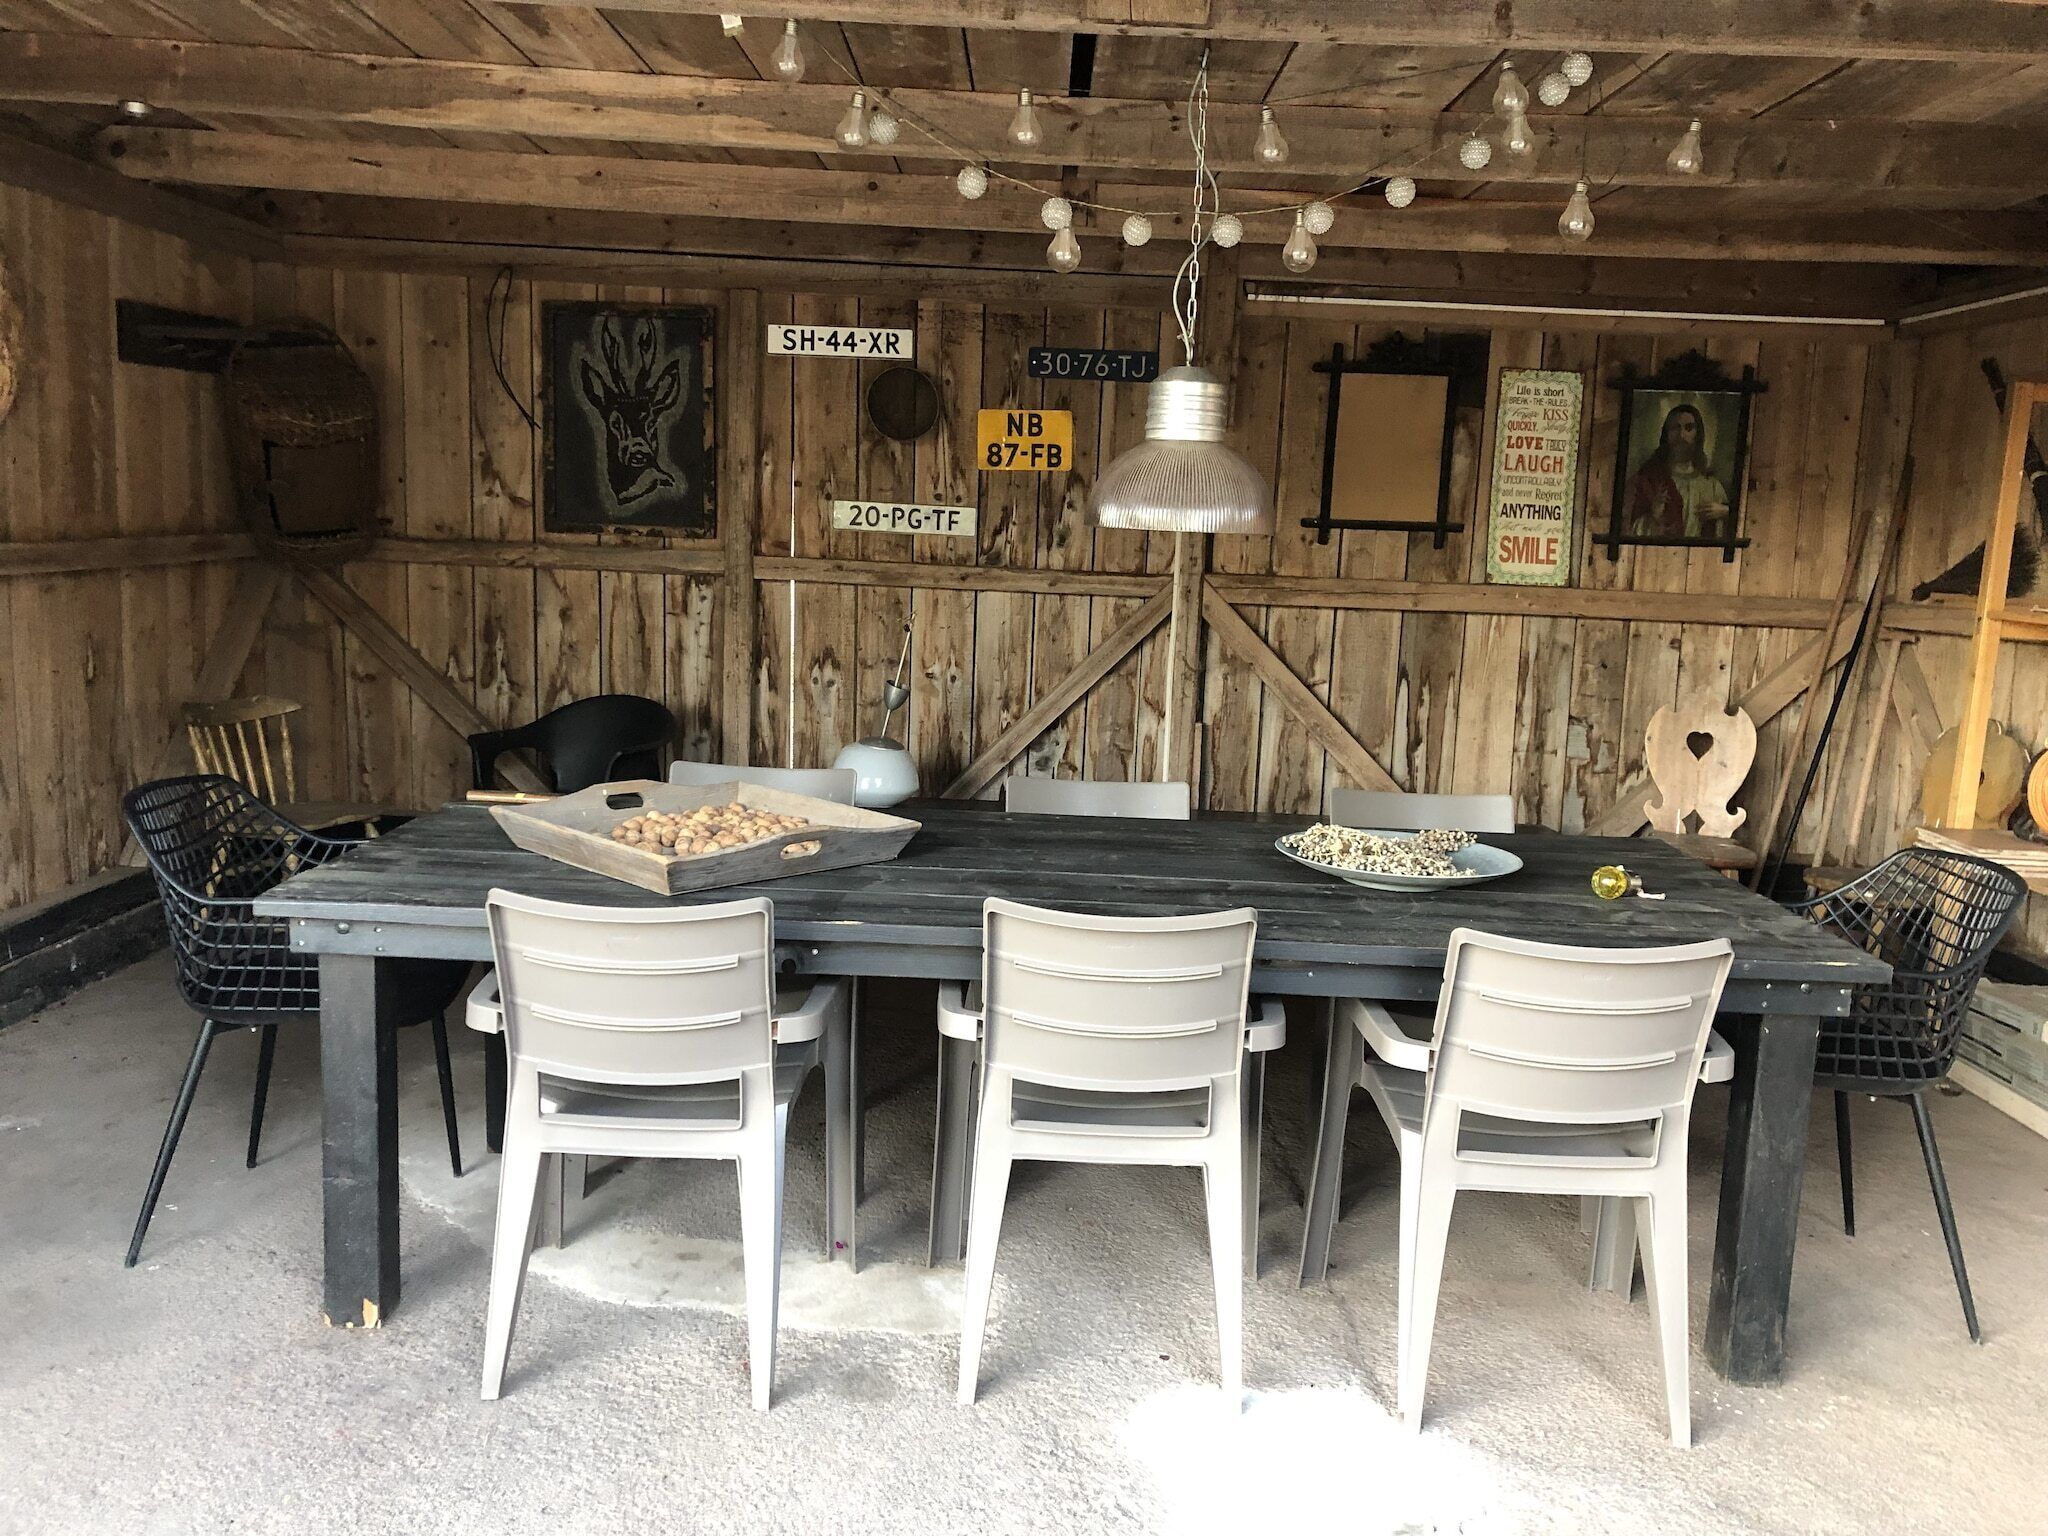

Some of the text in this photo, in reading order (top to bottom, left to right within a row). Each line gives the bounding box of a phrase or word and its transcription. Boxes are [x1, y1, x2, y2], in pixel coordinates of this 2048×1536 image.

[782, 329, 901, 355] SH-44-XR
[1516, 385, 1565, 397] Life is short
[1543, 408, 1569, 421] KISS
[1007, 413, 1044, 437] NB
[1506, 435, 1544, 450] LOVE
[987, 442, 1063, 468] 87-FB
[1504, 453, 1564, 473] LAUGH
[1535, 488, 1563, 502] Regret
[848, 505, 961, 532] 20-PG-TF
[1500, 503, 1561, 521] ANYTHING
[1499, 535, 1558, 565] SMILE
